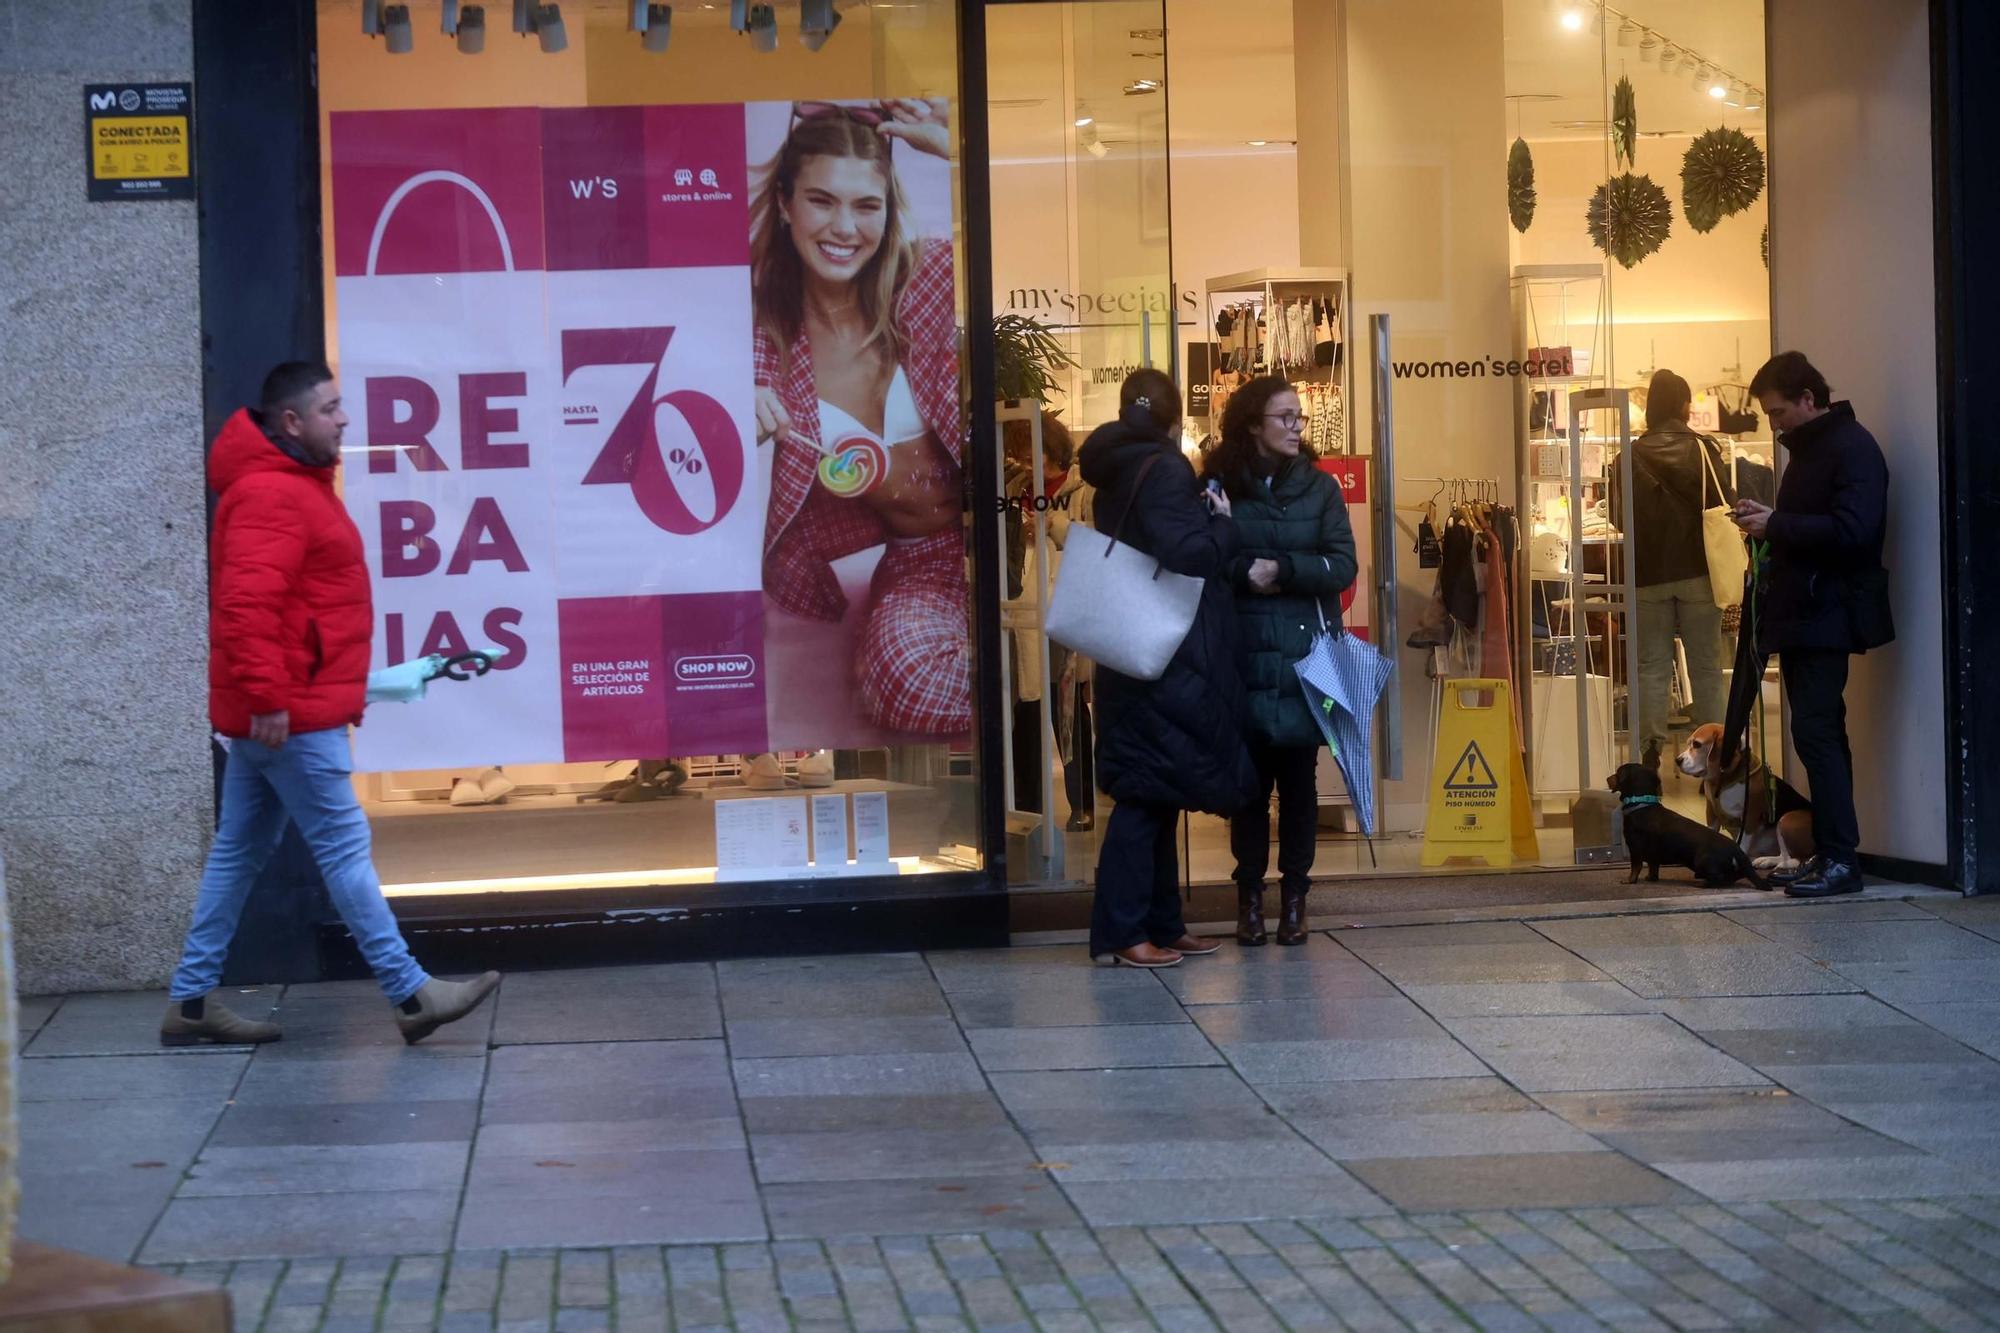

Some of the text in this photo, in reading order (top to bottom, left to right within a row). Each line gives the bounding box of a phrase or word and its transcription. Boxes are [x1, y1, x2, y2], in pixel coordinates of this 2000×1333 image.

[99, 127, 180, 137] CONECTADA
[662, 190, 732, 202] stores & online
[1393, 355, 1570, 379] women'secret
[563, 405, 598, 414] HASTA
[365, 372, 530, 474] RE
[380, 497, 530, 578] BA
[572, 660, 649, 673] EN UNA GRAN
[681, 661, 747, 674] SHOP NOW
[572, 672, 649, 684] SELECCIÓN DE
[583, 684, 644, 696] ARTÍCULOS
[1446, 789, 1496, 798] ATENCIÓN
